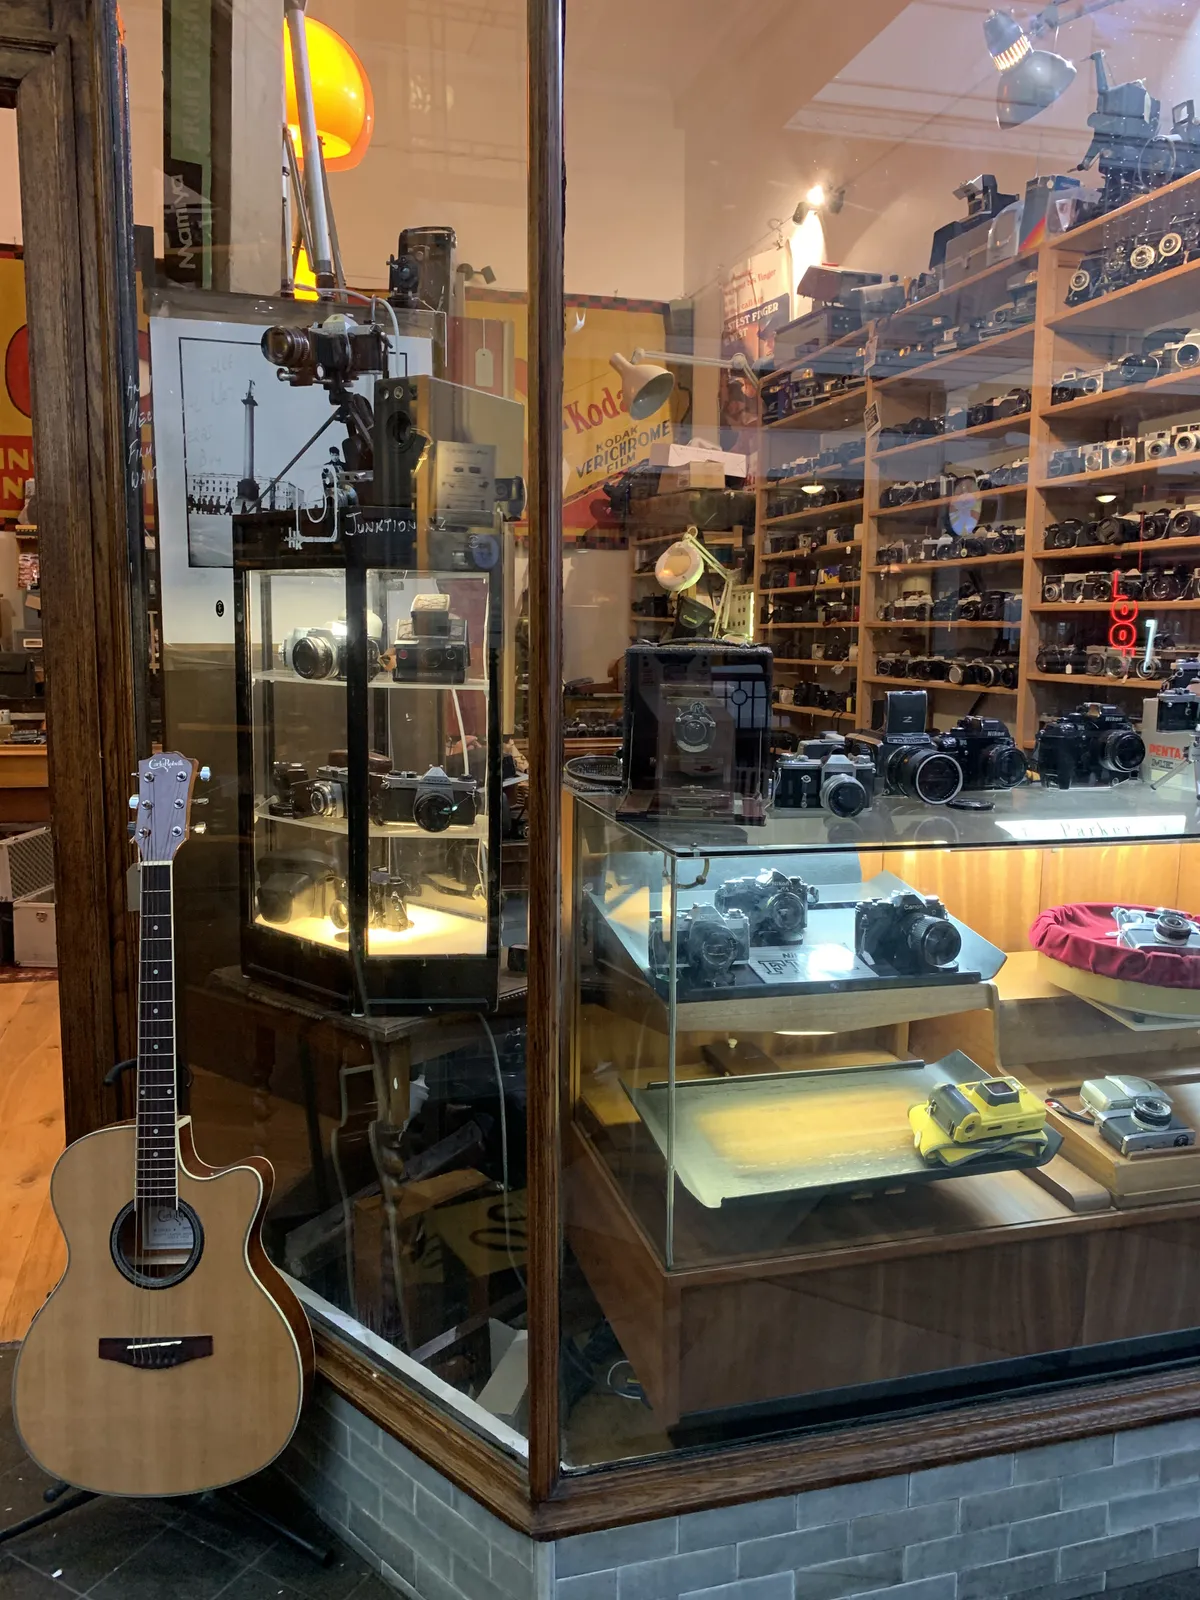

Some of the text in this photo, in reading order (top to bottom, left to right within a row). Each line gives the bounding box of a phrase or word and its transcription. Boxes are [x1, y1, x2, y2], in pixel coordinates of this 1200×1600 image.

[171, 174, 197, 270] Mamiya
[751, 301, 779, 322] FINGER
[564, 386, 630, 435] Kod
[576, 419, 671, 479] VERICHROME
[596, 424, 638, 453] KODAK
[606, 451, 636, 474] FILM
[1060, 821, 1131, 838] Parker
